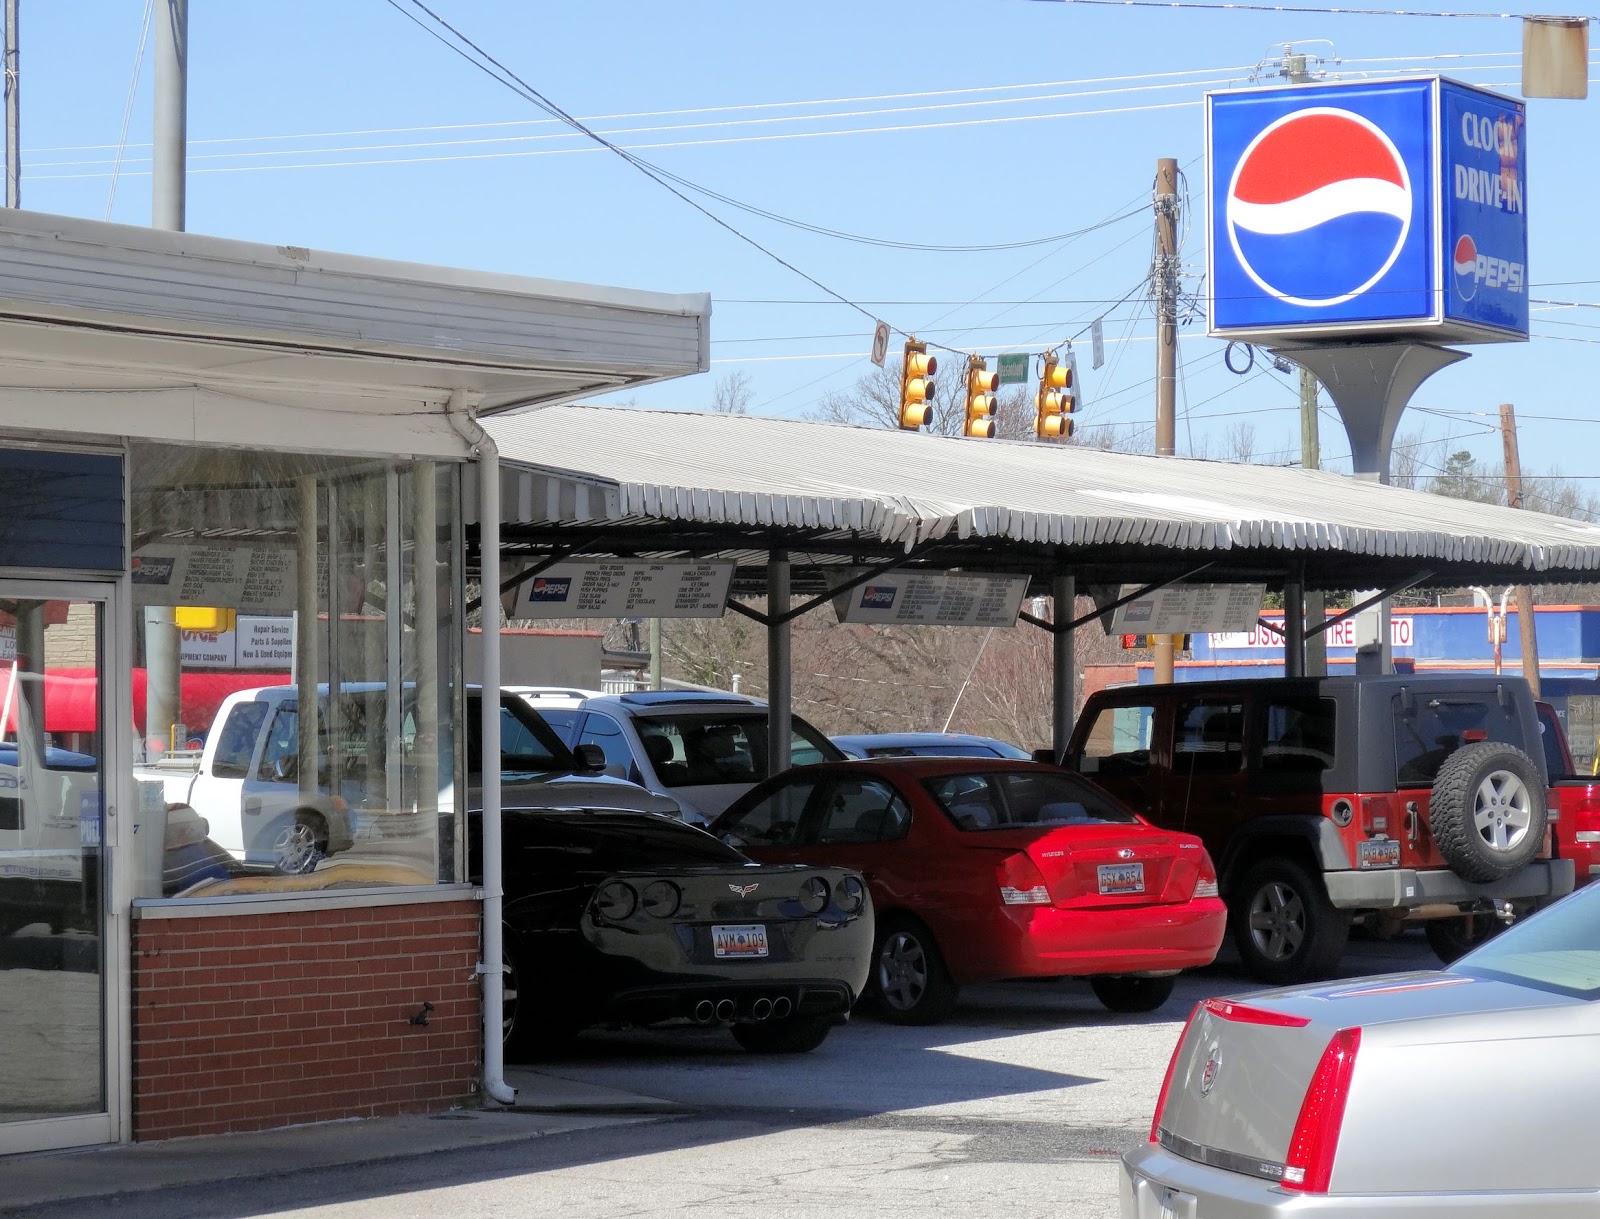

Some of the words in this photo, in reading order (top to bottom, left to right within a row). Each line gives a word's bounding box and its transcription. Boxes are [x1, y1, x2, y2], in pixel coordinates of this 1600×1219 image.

[1462, 111, 1514, 158] CLOCK
[1454, 163, 1523, 214] DRIVE-IN
[1474, 253, 1525, 294] PEPSI
[139, 565, 170, 576] PEPSI
[543, 583, 568, 594] PEPSI
[872, 592, 894, 602] PEPSI
[254, 625, 270, 634] Repair
[271, 625, 289, 633] Service
[1248, 621, 1286, 645] DISC
[1324, 621, 1353, 644] IRE
[1389, 620, 1410, 643] TO
[203, 654, 227, 662] COMPANY
[243, 650, 253, 658] New
[261, 650, 272, 658] Used
[274, 650, 292, 659] Equipm
[1125, 870, 1141, 885] 854
[746, 932, 764, 947] 109
